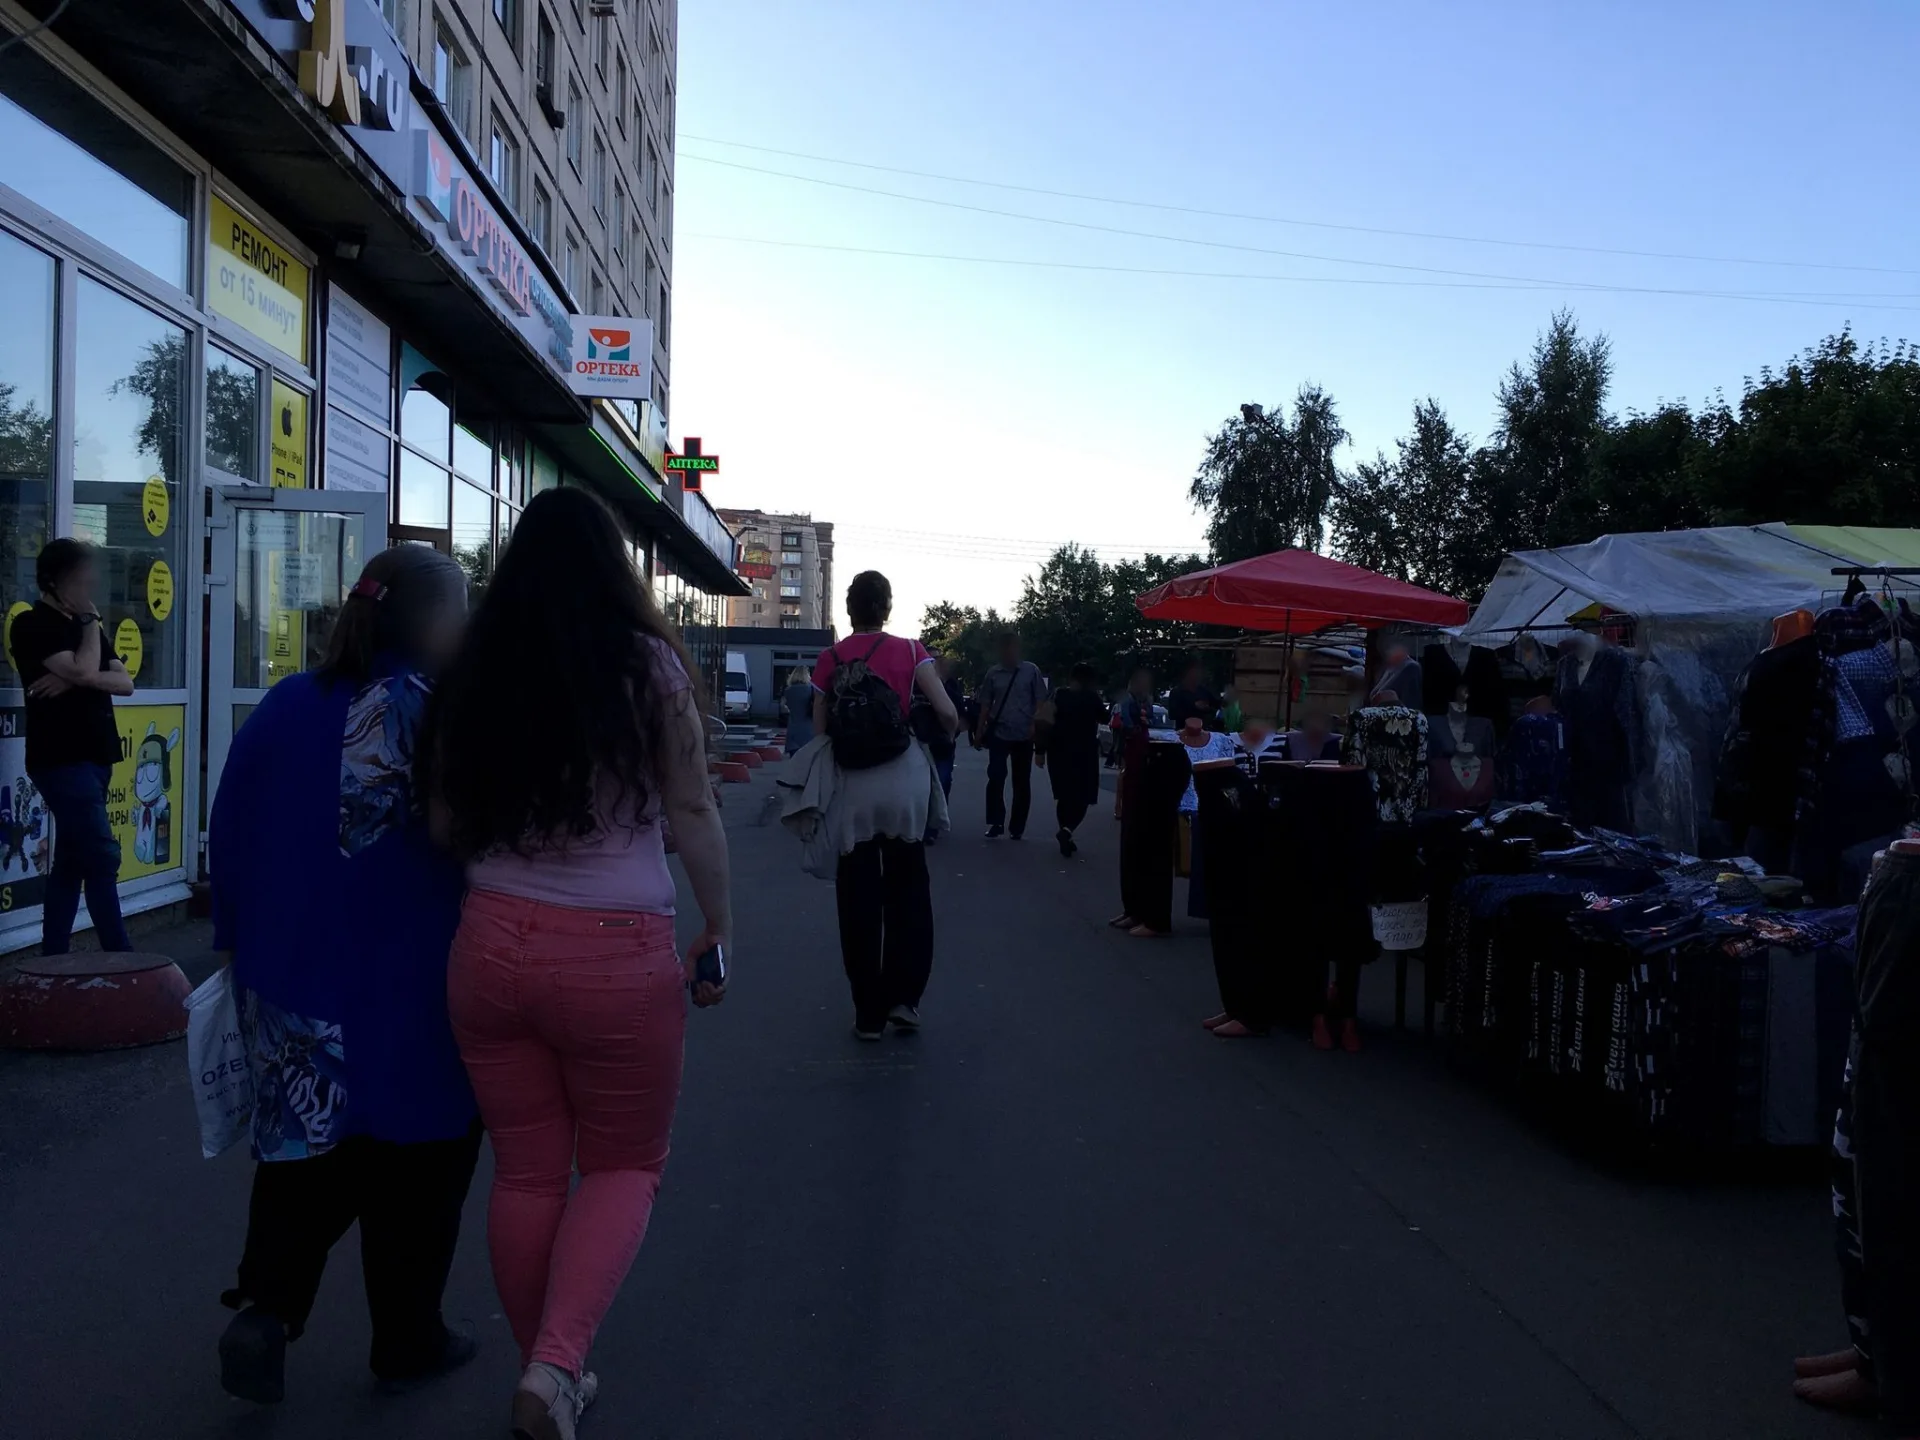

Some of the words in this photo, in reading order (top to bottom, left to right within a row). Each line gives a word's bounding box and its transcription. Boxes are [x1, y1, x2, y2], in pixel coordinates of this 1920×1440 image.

[231, 221, 289, 287] РЕМОНТ
[454, 179, 531, 317] ОРТЕКА
[220, 265, 236, 293] от
[240, 273, 255, 306] 15
[576, 361, 641, 377] ОРТЕКА
[667, 458, 717, 470] АПТЕКА
